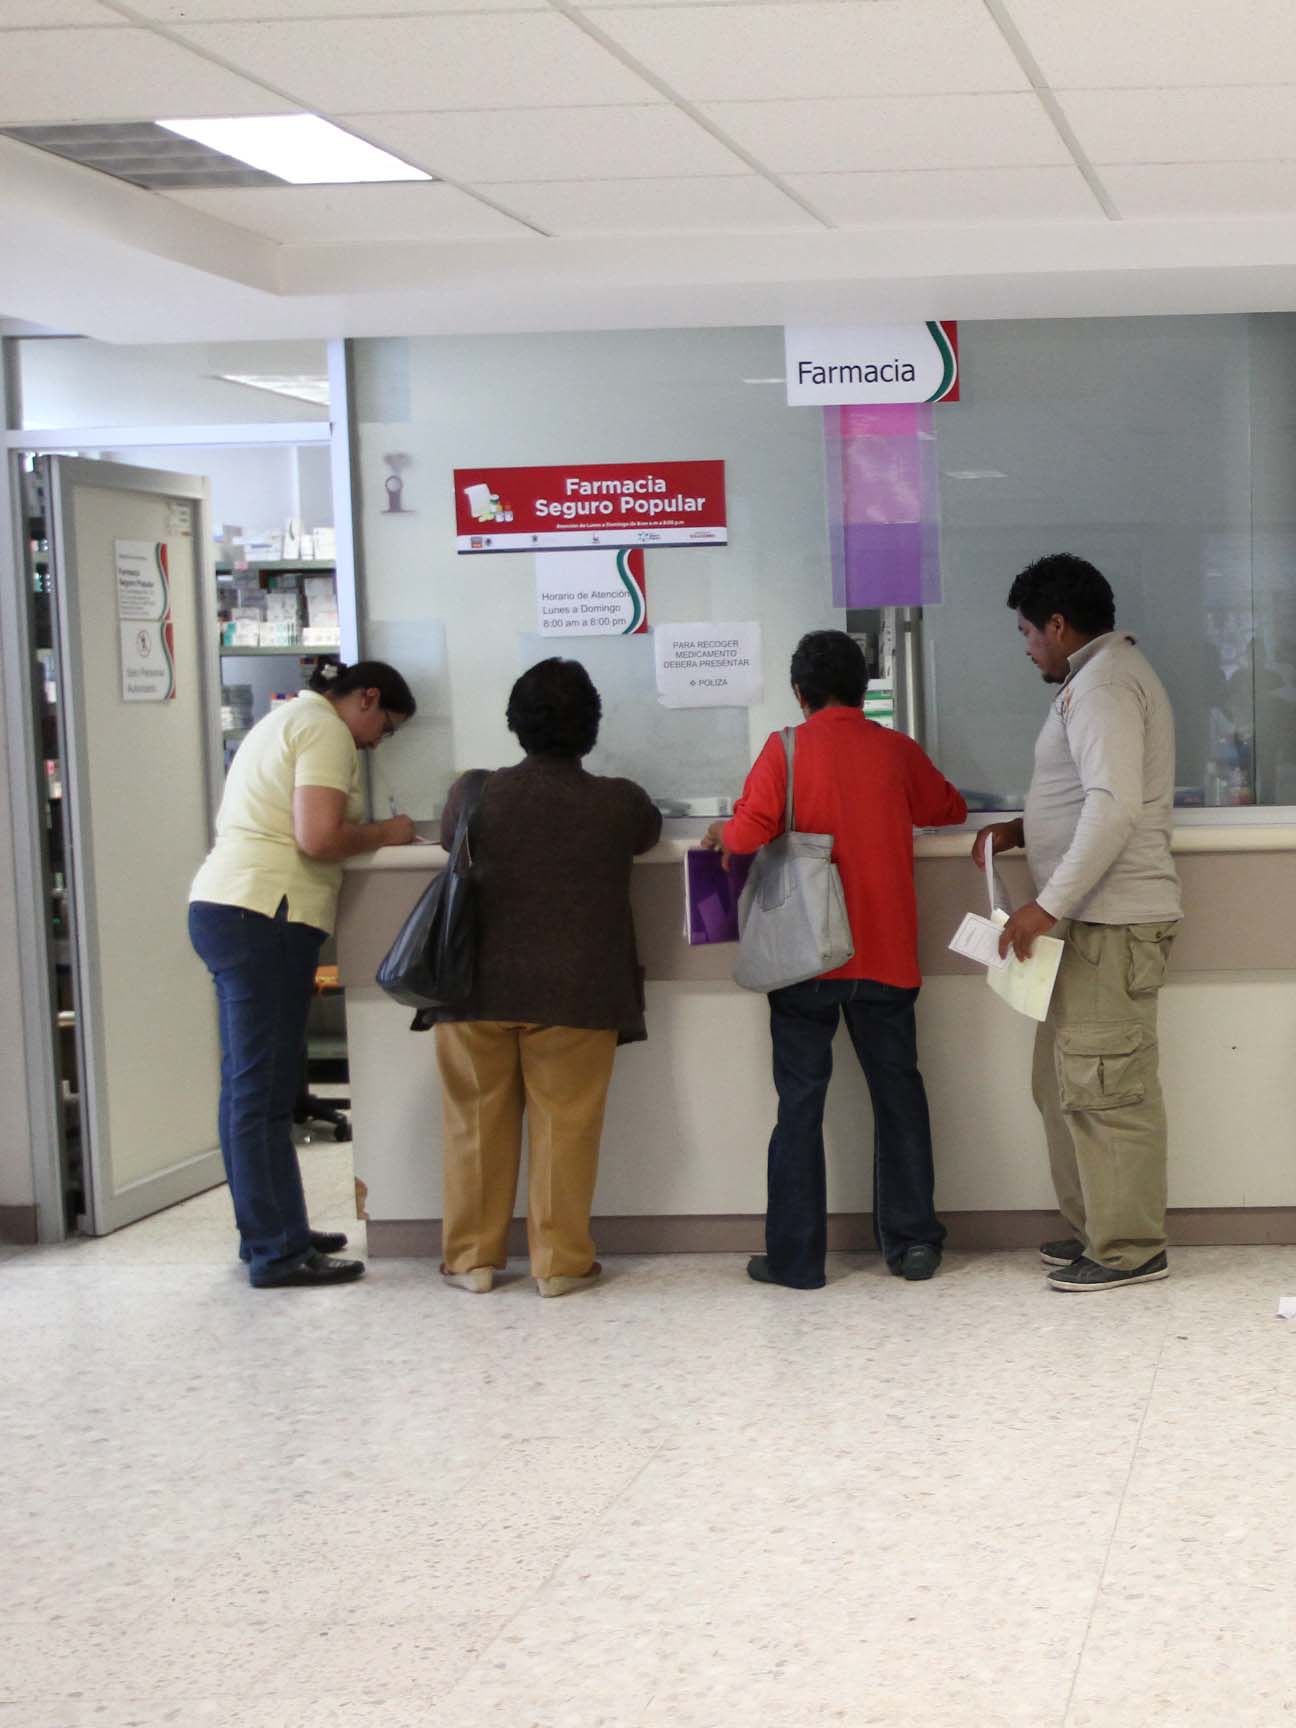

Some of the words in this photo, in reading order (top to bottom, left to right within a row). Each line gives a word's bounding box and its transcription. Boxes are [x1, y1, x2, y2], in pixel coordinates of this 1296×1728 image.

[798, 359, 915, 384] Farmacia
[566, 476, 666, 496] Farmacia
[535, 499, 614, 519] Seguro
[620, 495, 706, 519] Popular
[542, 592, 574, 601] Horario
[578, 592, 588, 600] de
[591, 590, 630, 599] Atención
[543, 606, 570, 615] Lunes
[572, 606, 578, 614] a
[580, 604, 621, 614] Domingo
[544, 620, 563, 628] 8:00
[565, 620, 580, 628] am
[590, 618, 610, 626] 8:00
[612, 618, 626, 627] pm
[673, 641, 696, 649] PARA
[698, 640, 739, 648] RECOGER
[675, 650, 737, 659] MEDICAMENTO
[664, 660, 698, 669] DEBERA
[699, 658, 750, 668] PRESENTAR
[698, 678, 728, 687] POLIZA
